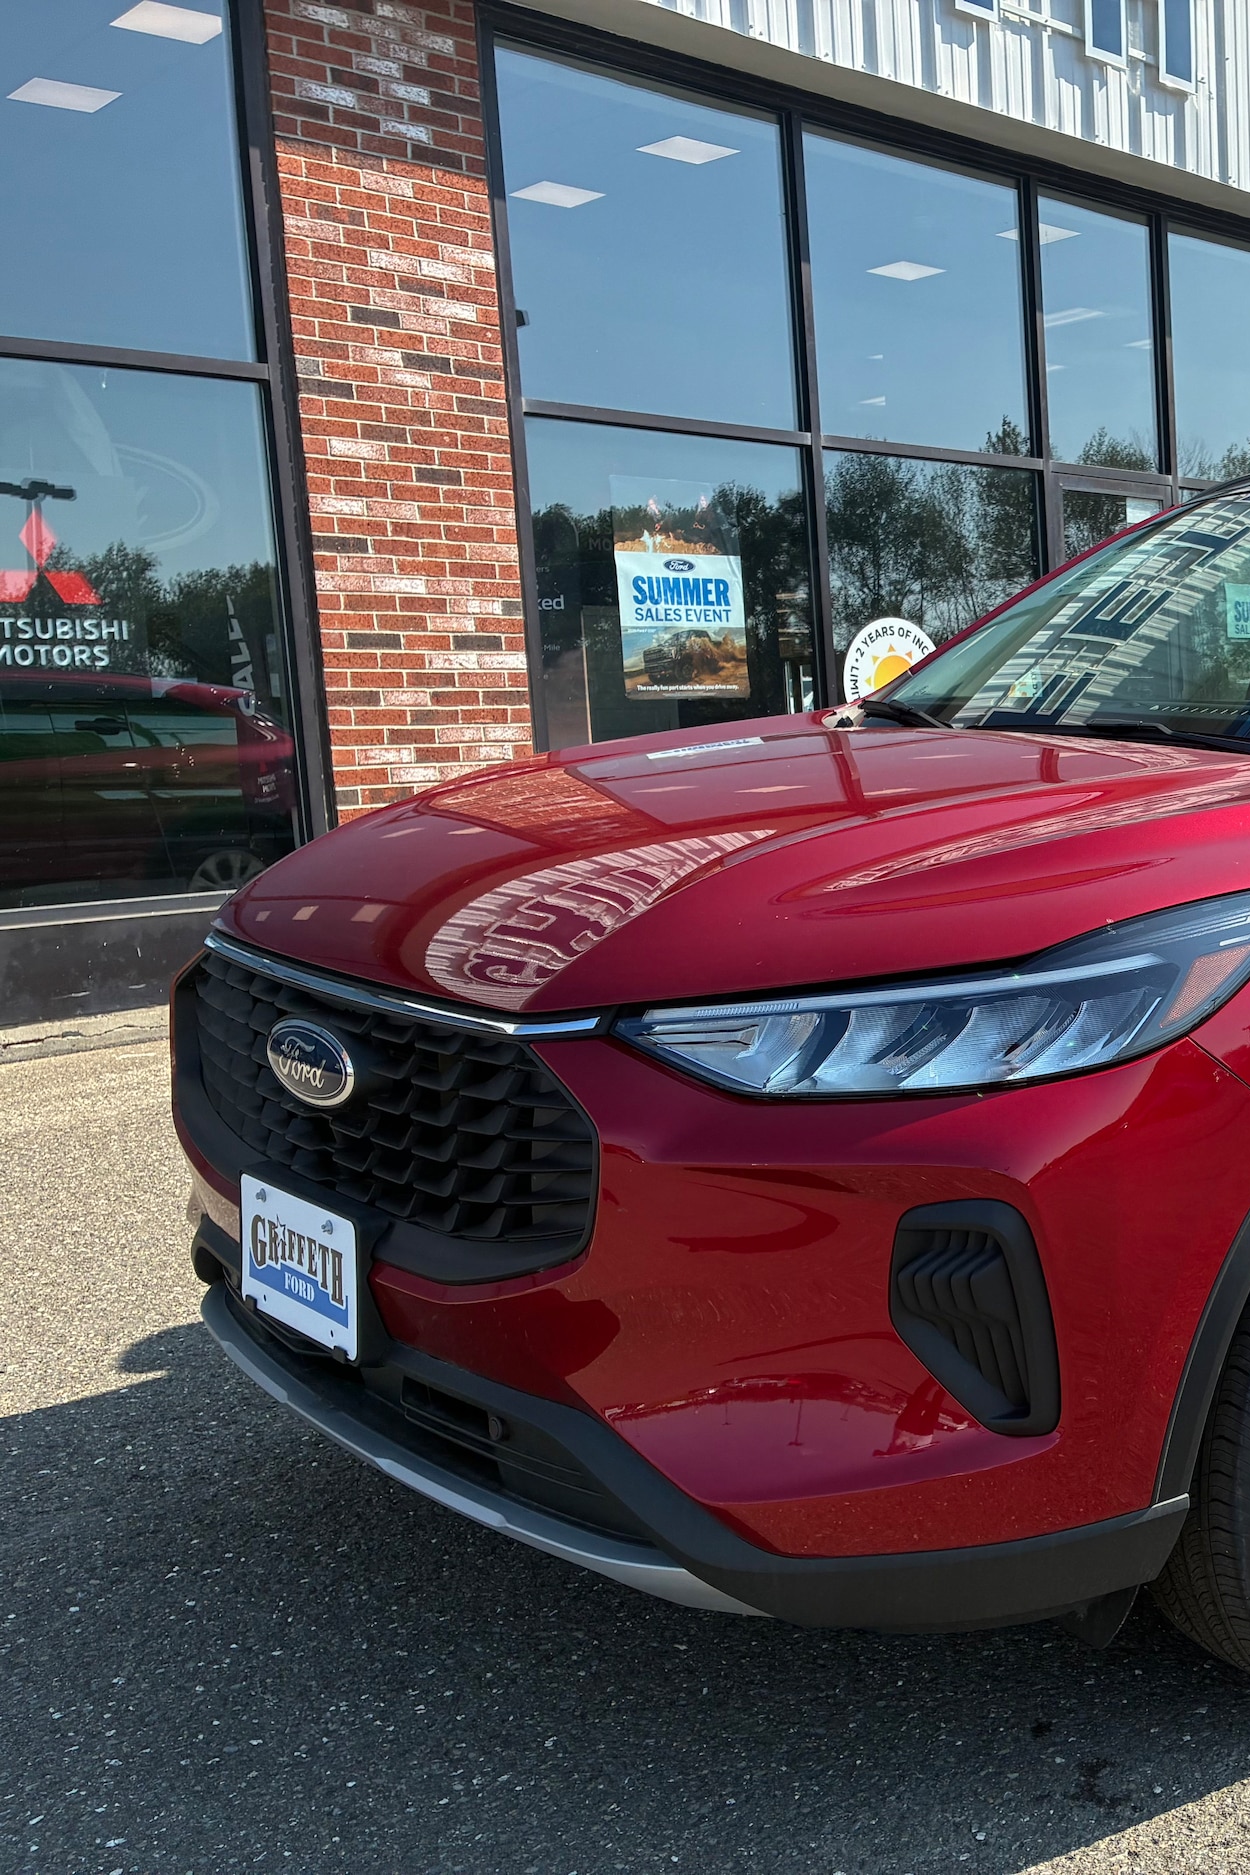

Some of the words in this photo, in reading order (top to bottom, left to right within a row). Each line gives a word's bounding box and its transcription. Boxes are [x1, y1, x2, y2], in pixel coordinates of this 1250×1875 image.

[668, 560, 690, 571] Ford
[632, 575, 731, 607] SUMMER
[635, 608, 682, 622] SALES
[686, 609, 732, 623] EVENT
[855, 647, 865, 658] 2
[861, 625, 895, 648] YEARS
[897, 627, 912, 640] OF
[280, 1036, 326, 1089] Ford
[251, 1213, 344, 1307] GRIFFETH
[284, 1271, 315, 1302] FORD
